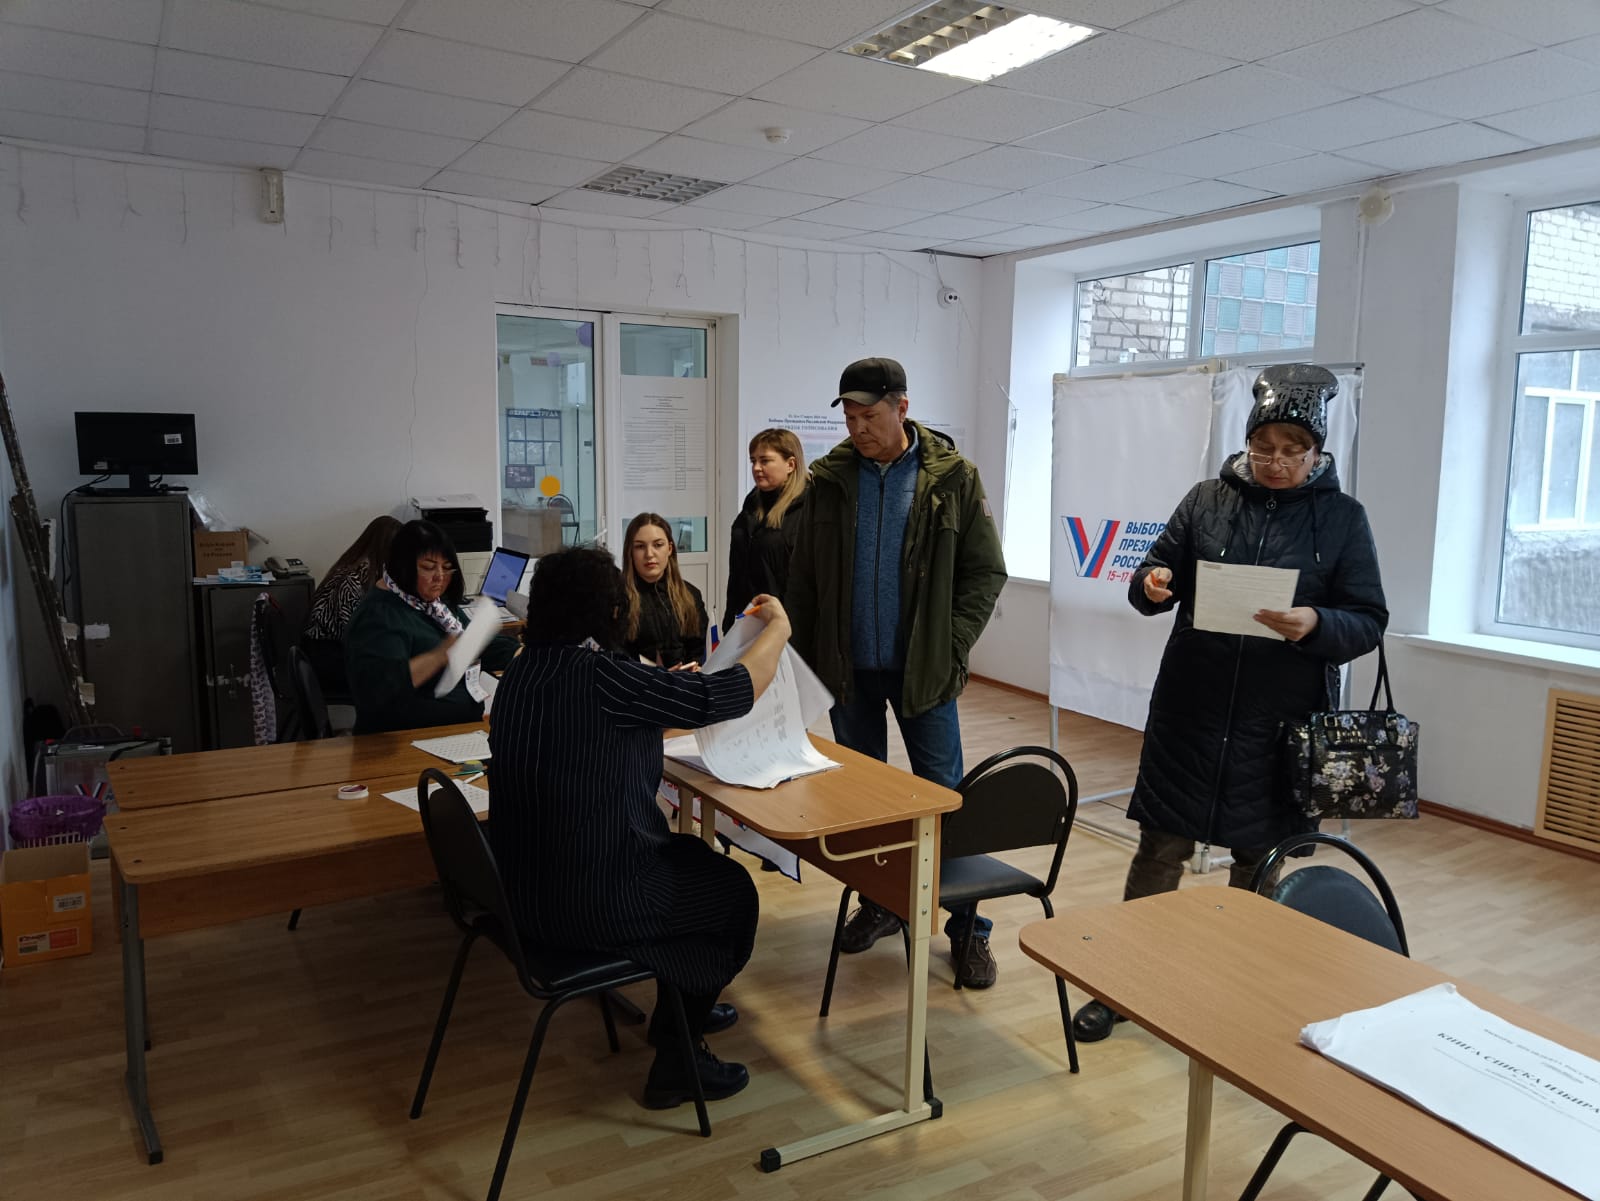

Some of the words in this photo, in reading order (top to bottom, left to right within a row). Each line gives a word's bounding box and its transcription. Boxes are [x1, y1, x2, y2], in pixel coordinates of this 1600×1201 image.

[1125, 521, 1166, 536] ВЫБОР
[1118, 538, 1155, 552] ПРЕЗИ
[1111, 555, 1143, 568] РОСС
[1437, 1032, 1480, 1056] КНИГА
[1483, 1055, 1541, 1084] СПИСКА
[1544, 1083, 1600, 1114] ИЗБИРА
